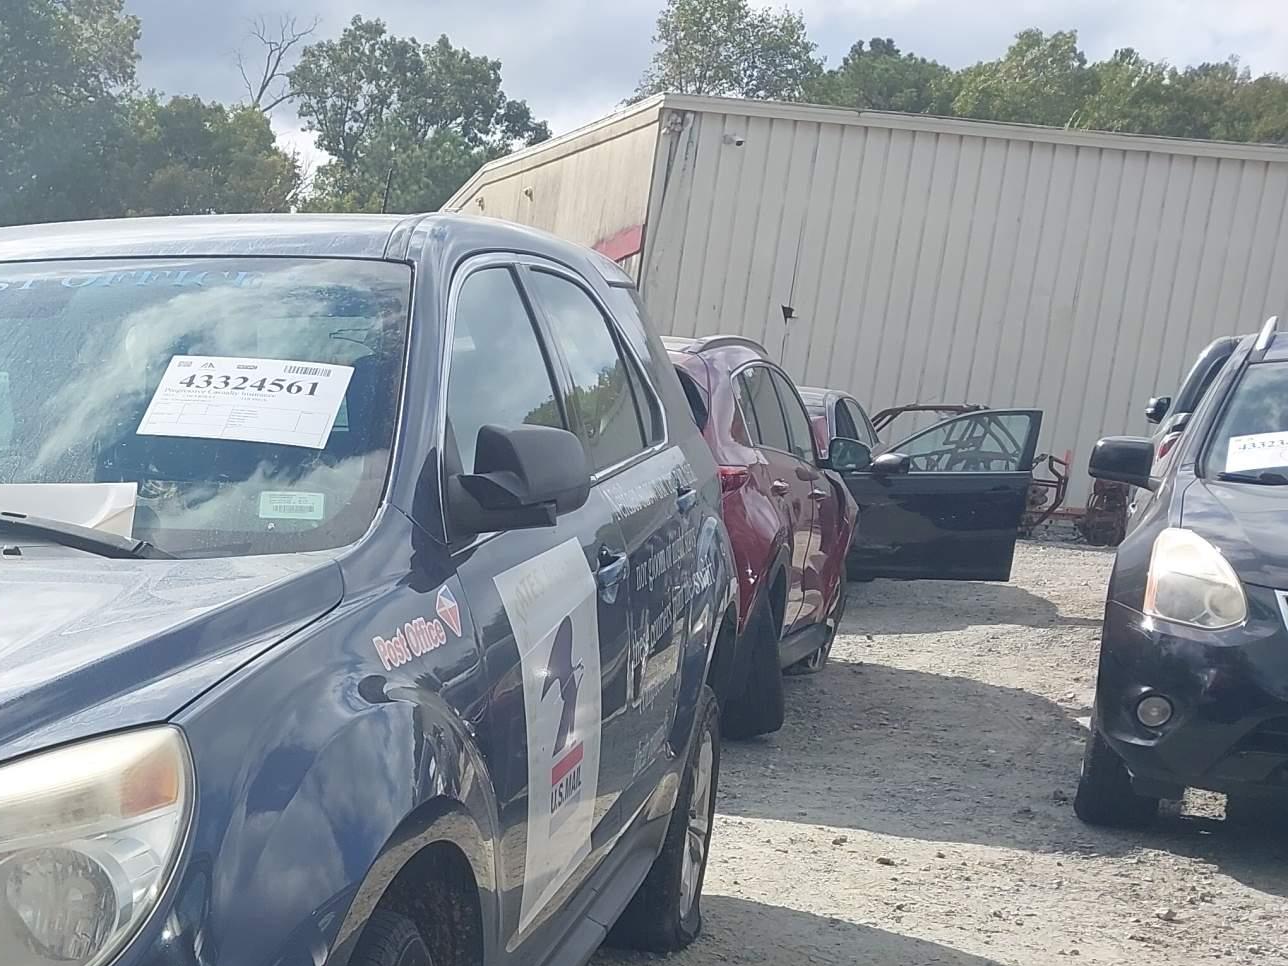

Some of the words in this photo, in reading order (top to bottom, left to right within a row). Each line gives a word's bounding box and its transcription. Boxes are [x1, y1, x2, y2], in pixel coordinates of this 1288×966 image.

[179, 374, 319, 395] 43324561
[372, 627, 412, 671] Post
[404, 616, 447, 657] Office
